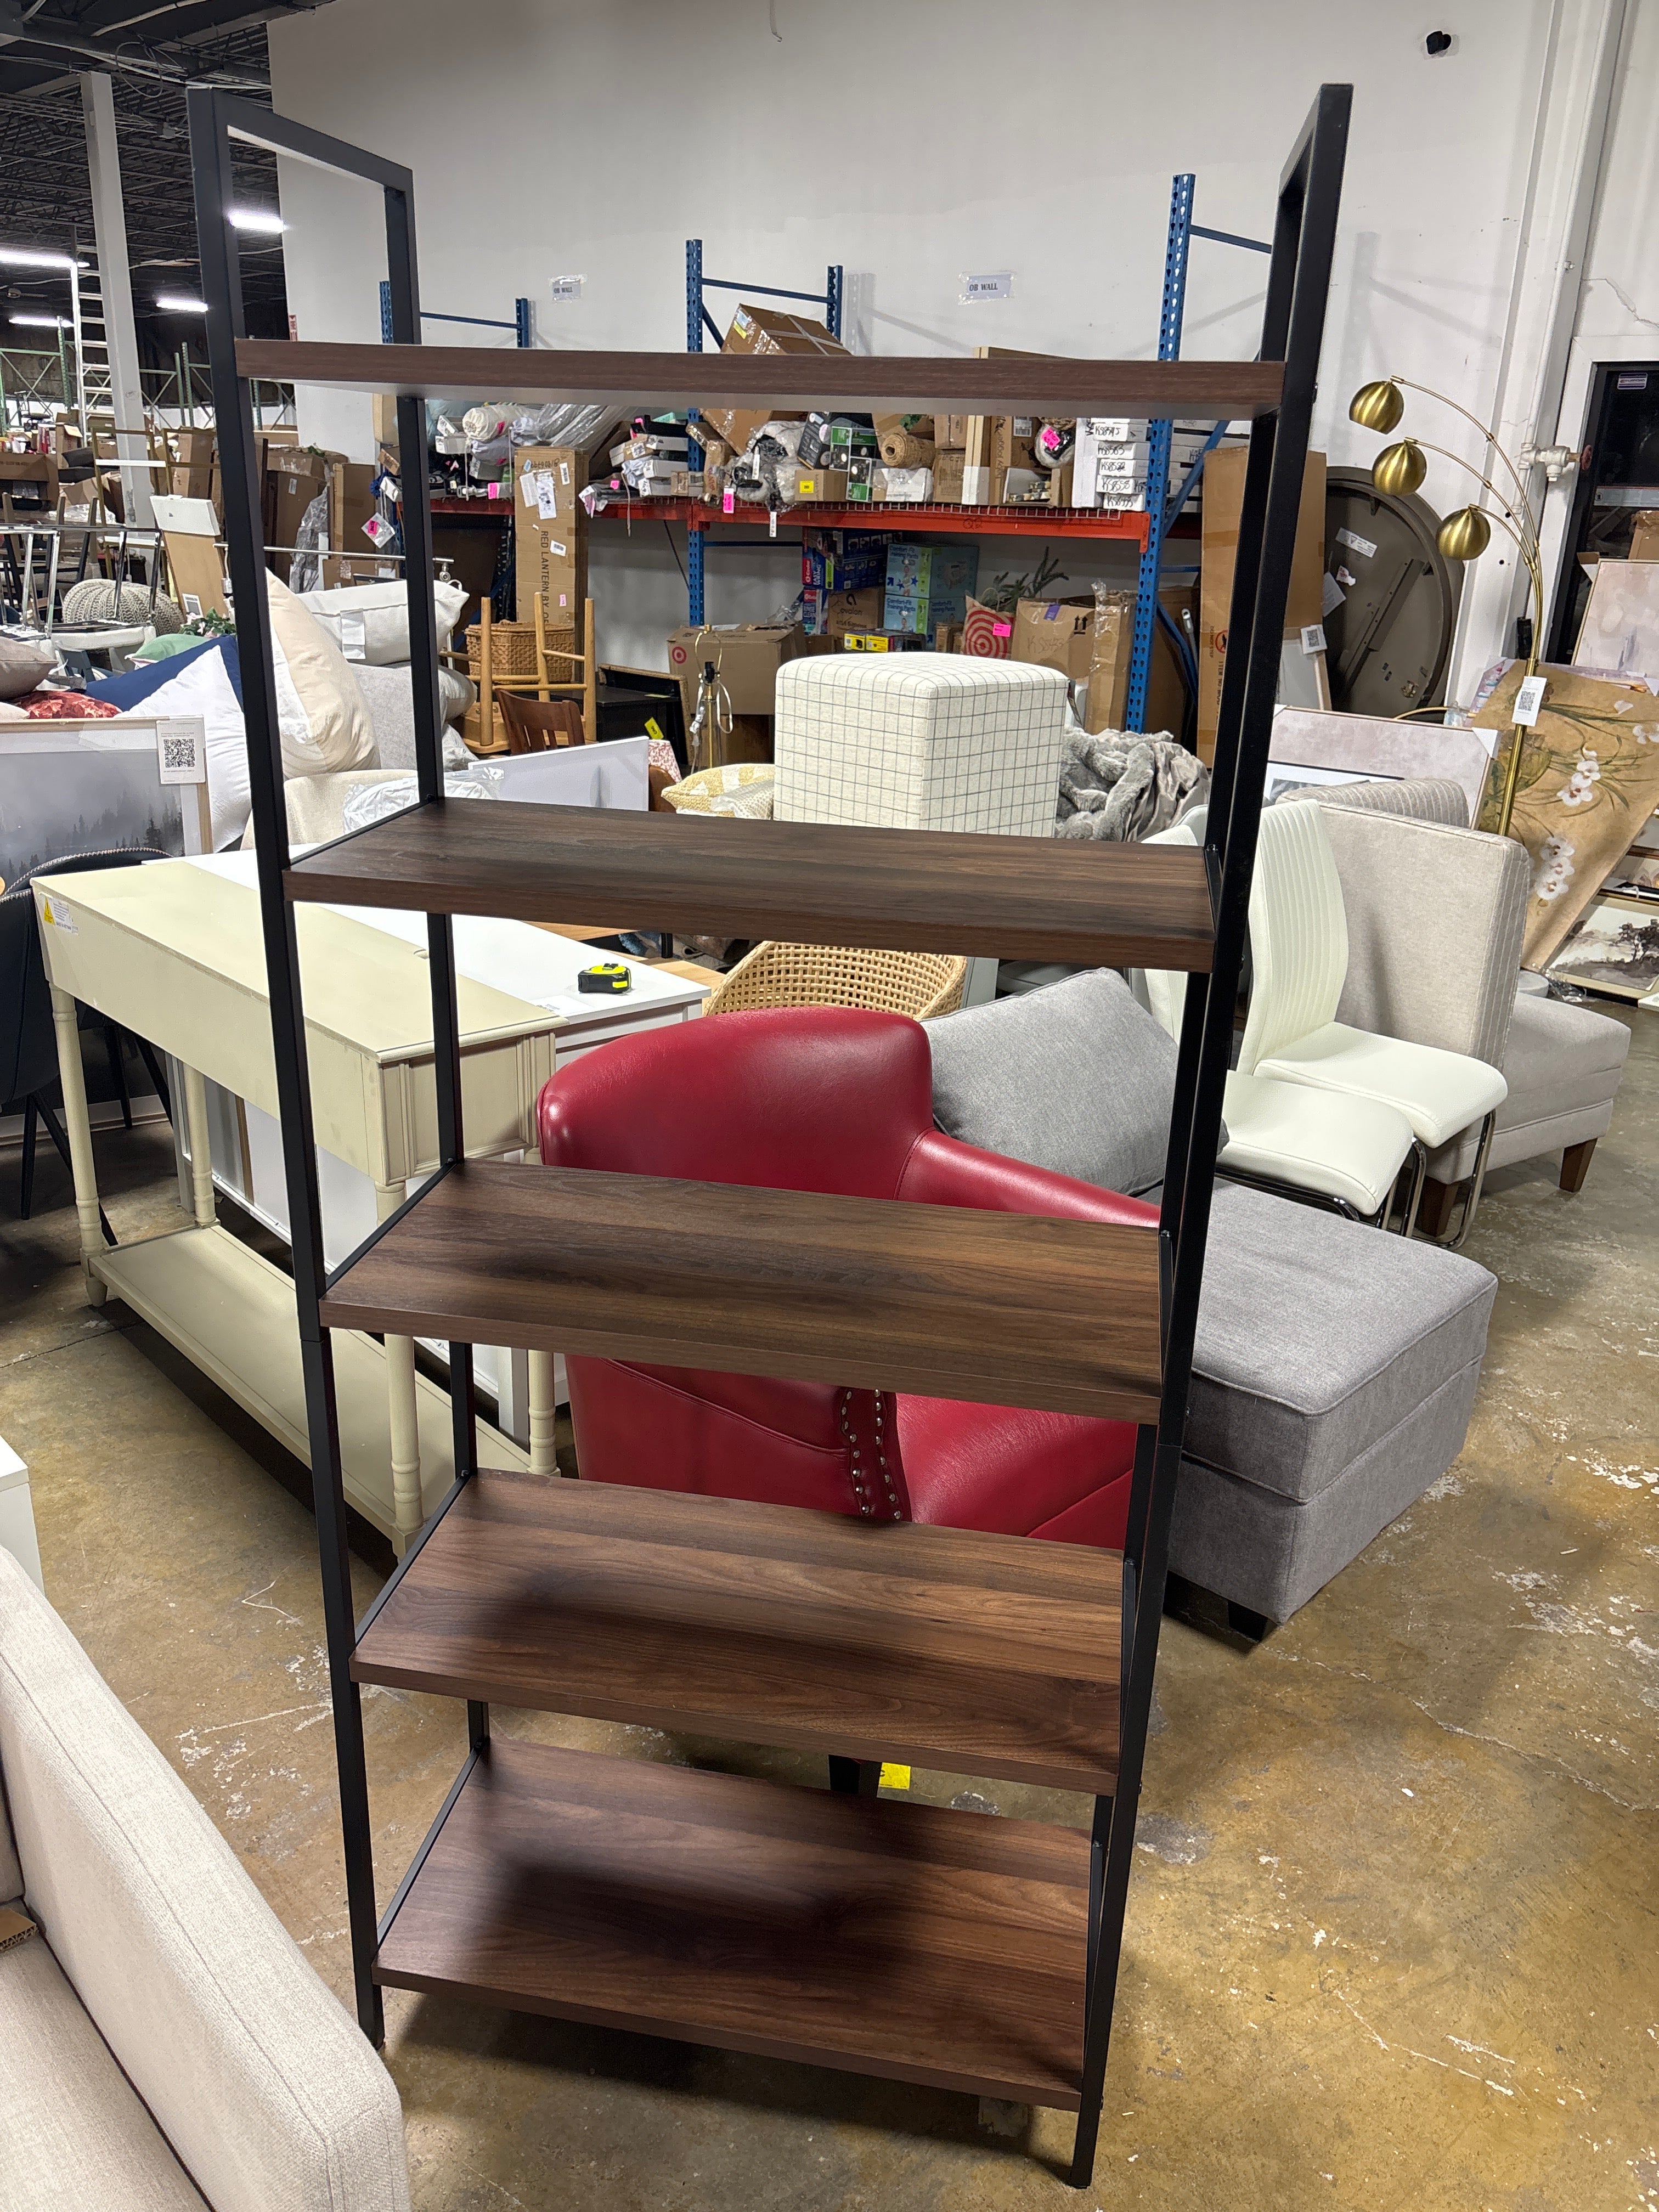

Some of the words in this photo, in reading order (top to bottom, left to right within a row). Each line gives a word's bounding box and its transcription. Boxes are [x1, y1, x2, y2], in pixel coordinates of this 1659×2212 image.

[981, 283, 998, 291] WALL
[541, 551, 549, 592] LANTERN
[541, 596, 549, 608] BY
